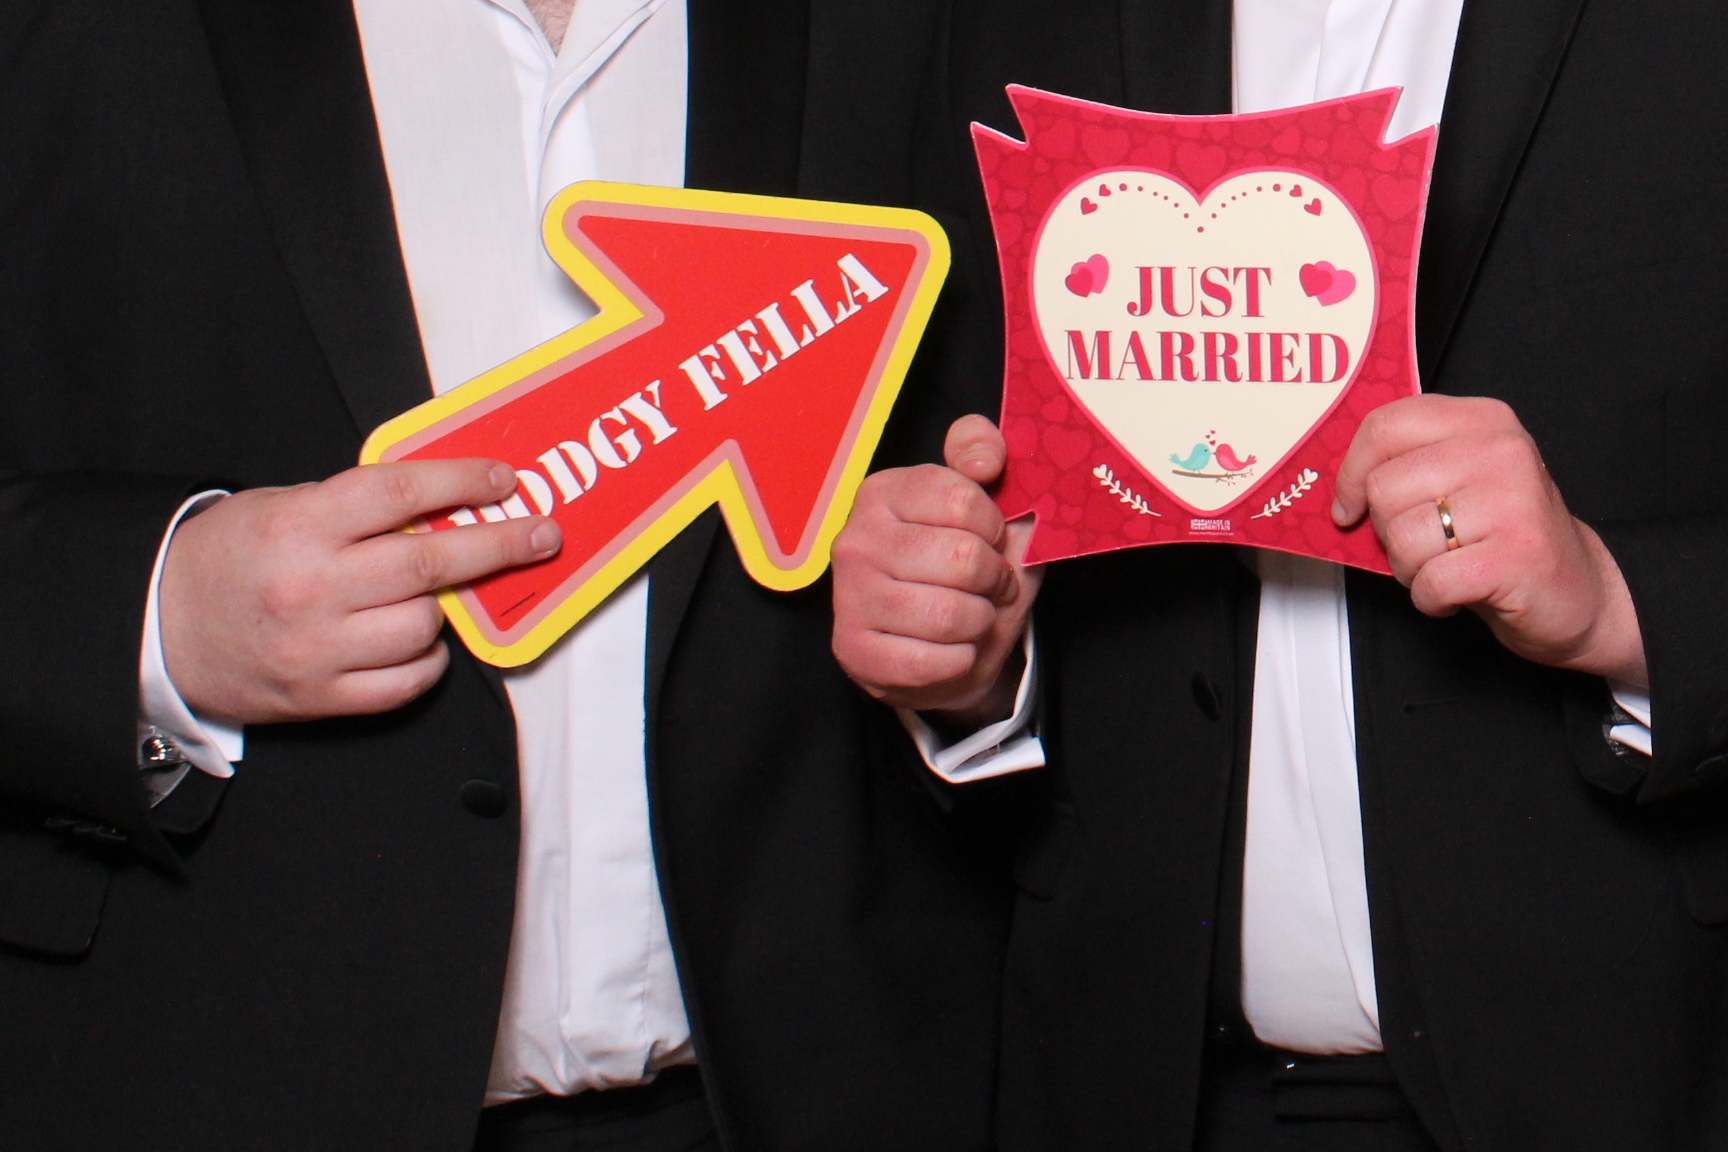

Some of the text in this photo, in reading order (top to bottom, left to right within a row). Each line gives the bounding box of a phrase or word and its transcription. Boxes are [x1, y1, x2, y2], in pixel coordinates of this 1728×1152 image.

[1126, 265, 1273, 319] JUST
[677, 253, 890, 412] FELLA
[1063, 328, 1350, 385] MARRIED
